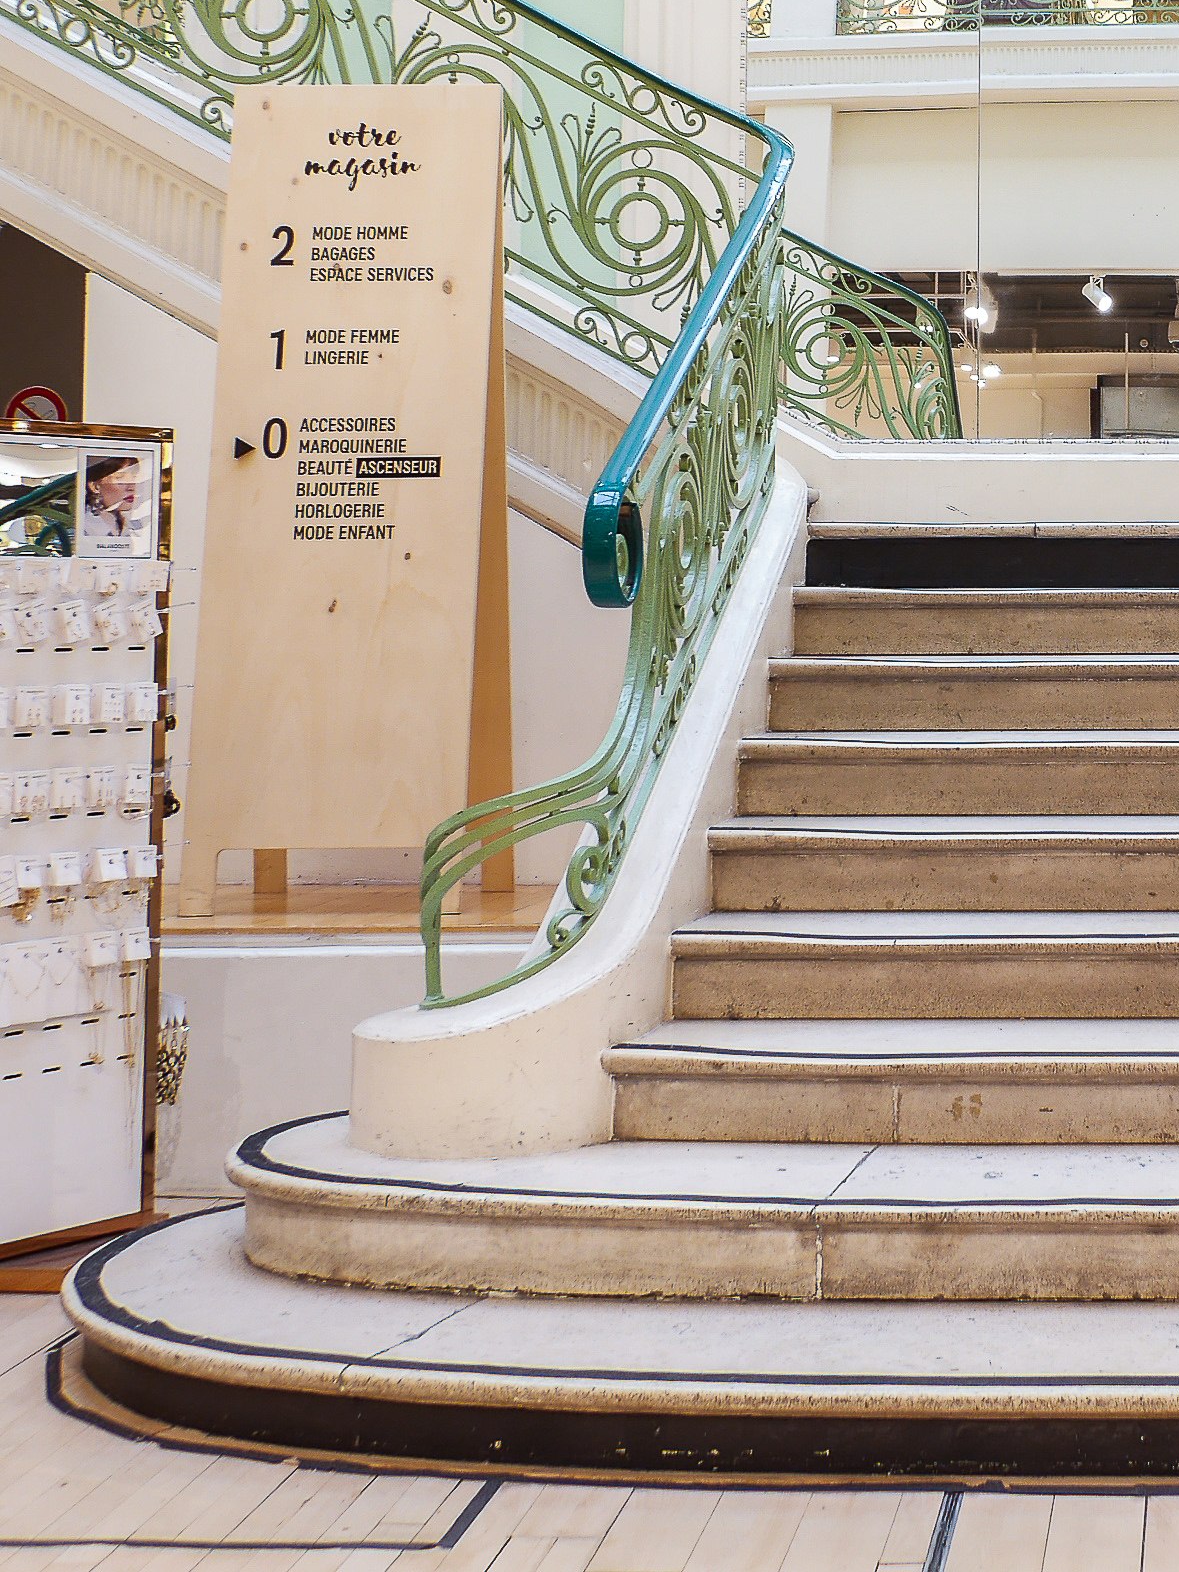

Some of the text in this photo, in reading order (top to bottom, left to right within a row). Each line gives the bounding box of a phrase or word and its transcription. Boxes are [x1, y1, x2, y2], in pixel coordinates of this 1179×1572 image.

[328, 122, 401, 148] votre
[304, 151, 421, 191] magasin
[312, 226, 408, 240] MODE HOMME
[270, 226, 295, 266] 2
[311, 247, 375, 261] BAGAGES
[310, 267, 434, 282] ESPACE SERVICES
[305, 330, 400, 344] MODE FEMME
[270, 330, 286, 370] 1
[304, 351, 369, 365] LINGERIE
[300, 418, 396, 433] ACCESSOIRES
[263, 418, 287, 459] 0
[298, 439, 407, 454] MAROQUINERIE
[297, 458, 437, 475] BEAUTÉ ASCENSEUR
[296, 481, 380, 497] BIJOUTERIE
[295, 503, 385, 519] HORLOGERIE
[293, 524, 396, 540] MODE ENFANT
